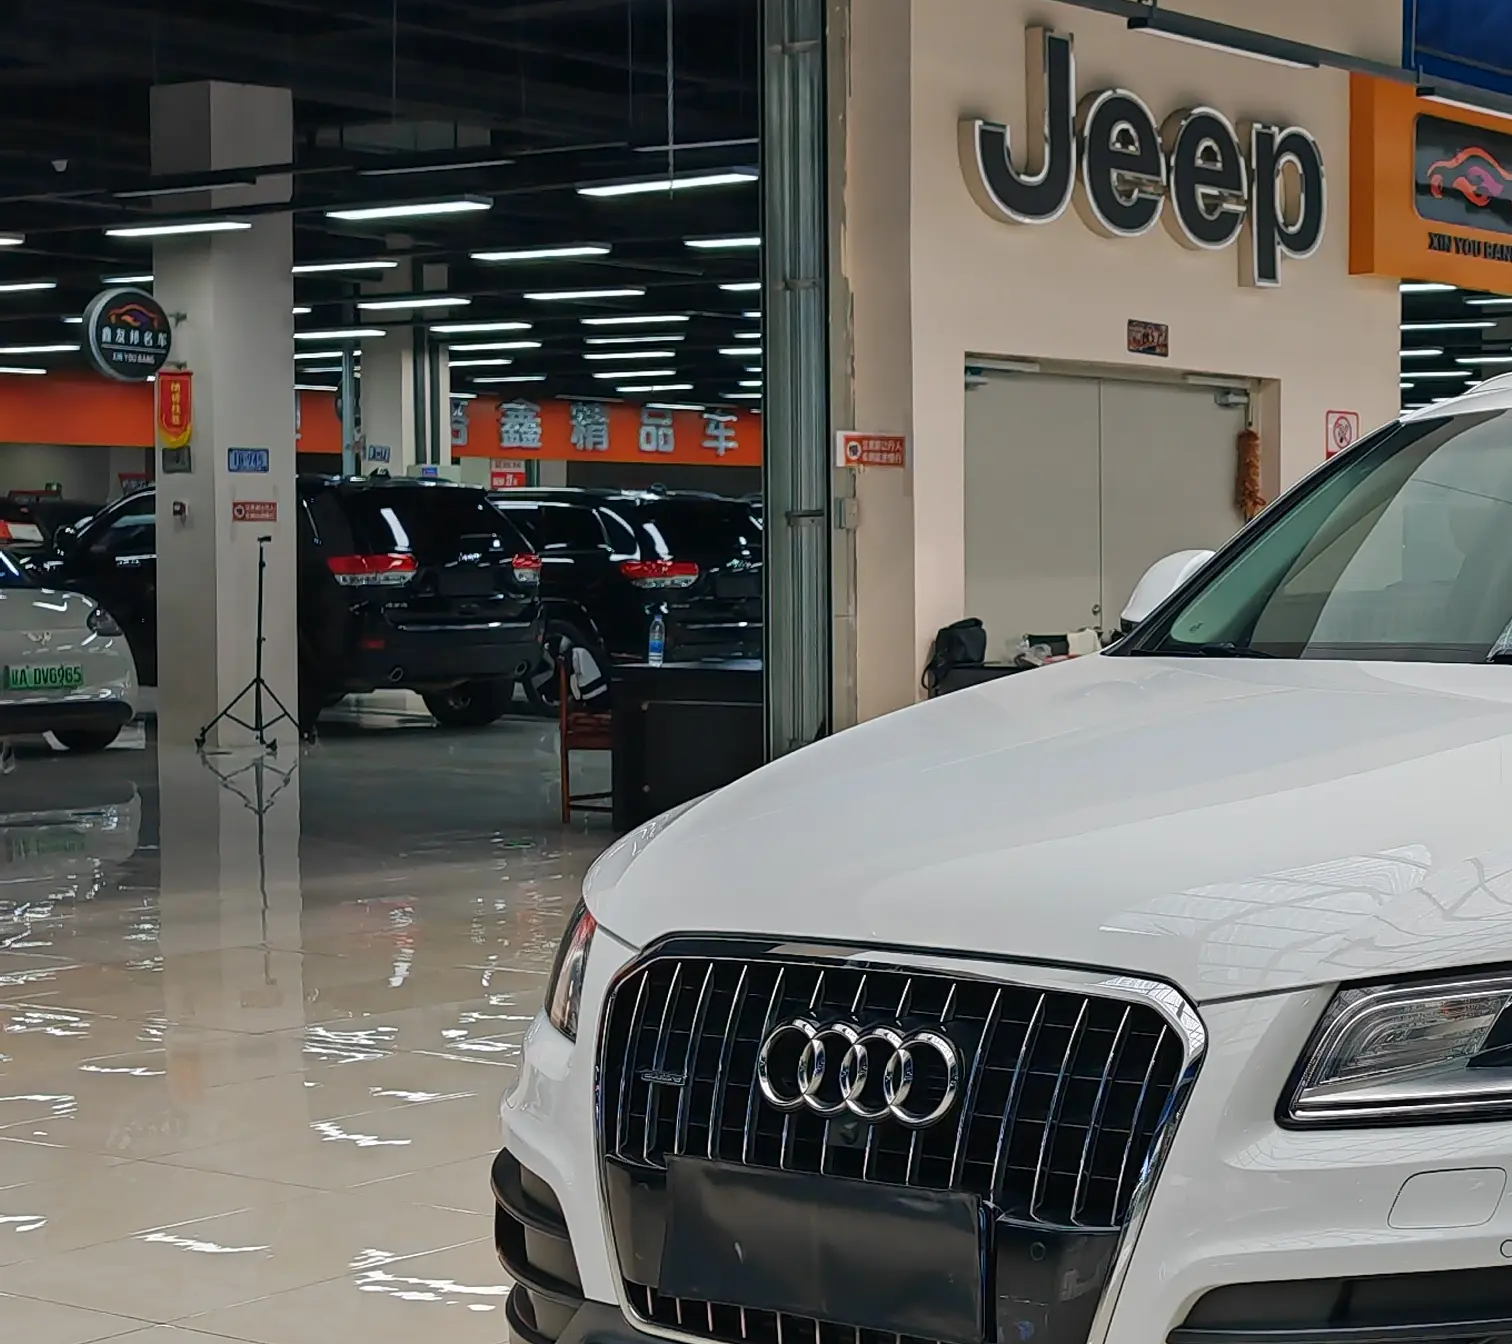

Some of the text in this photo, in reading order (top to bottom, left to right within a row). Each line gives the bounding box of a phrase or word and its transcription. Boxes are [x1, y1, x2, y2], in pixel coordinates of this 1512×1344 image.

[958, 26, 1327, 288] Jeep
[1428, 231, 1452, 253] XIN
[1453, 236, 1482, 258] YOU
